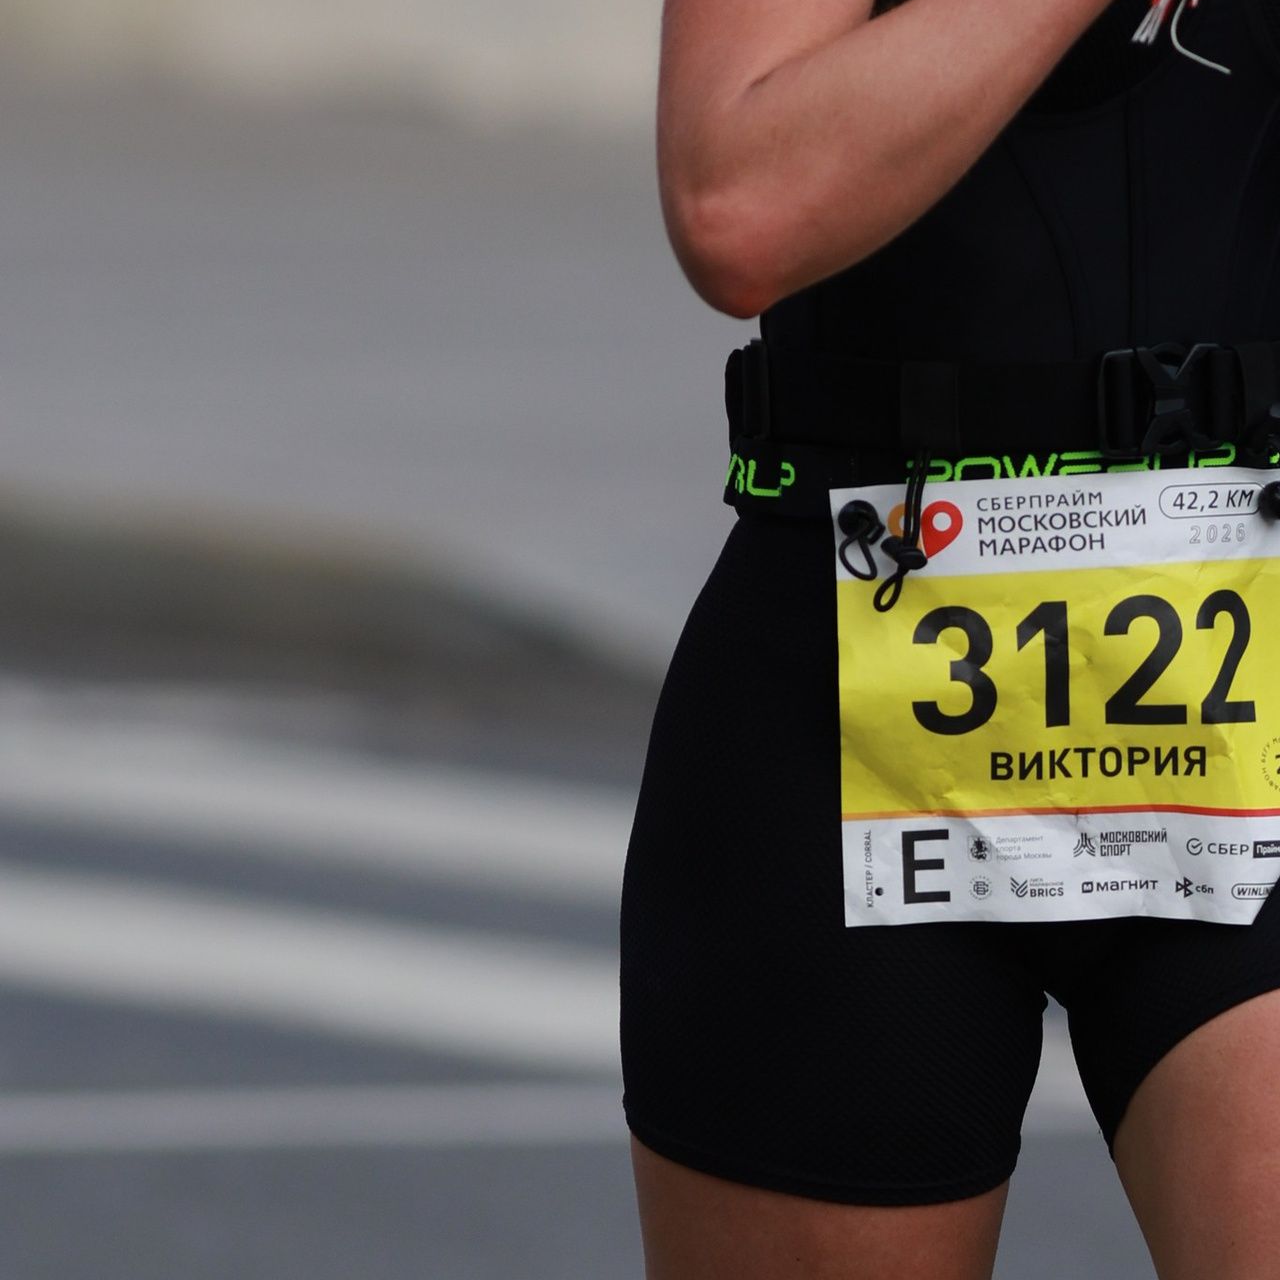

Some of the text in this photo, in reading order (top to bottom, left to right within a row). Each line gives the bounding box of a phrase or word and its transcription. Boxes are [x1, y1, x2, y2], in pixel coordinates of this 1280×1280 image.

[976, 491, 1103, 512] СБЕРПРАЙМ
[1172, 490, 1219, 513] 42,2
[977, 504, 1147, 535] МОСКОВСКИЙ
[978, 532, 1106, 557] МАРАФОН
[1188, 522, 1247, 545] 2026
[911, 588, 1257, 736] 3122
[990, 745, 1207, 781] ВИКТОРИЯ
[864, 829, 873, 863] CORRAL
[1100, 827, 1168, 844] МОСКОВСКИЙ
[1100, 843, 1131, 857] СПОРТ
[1207, 842, 1250, 856] СБЕР
[865, 870, 874, 909] КЛАСТЕР
[1029, 887, 1065, 898] BRICS
